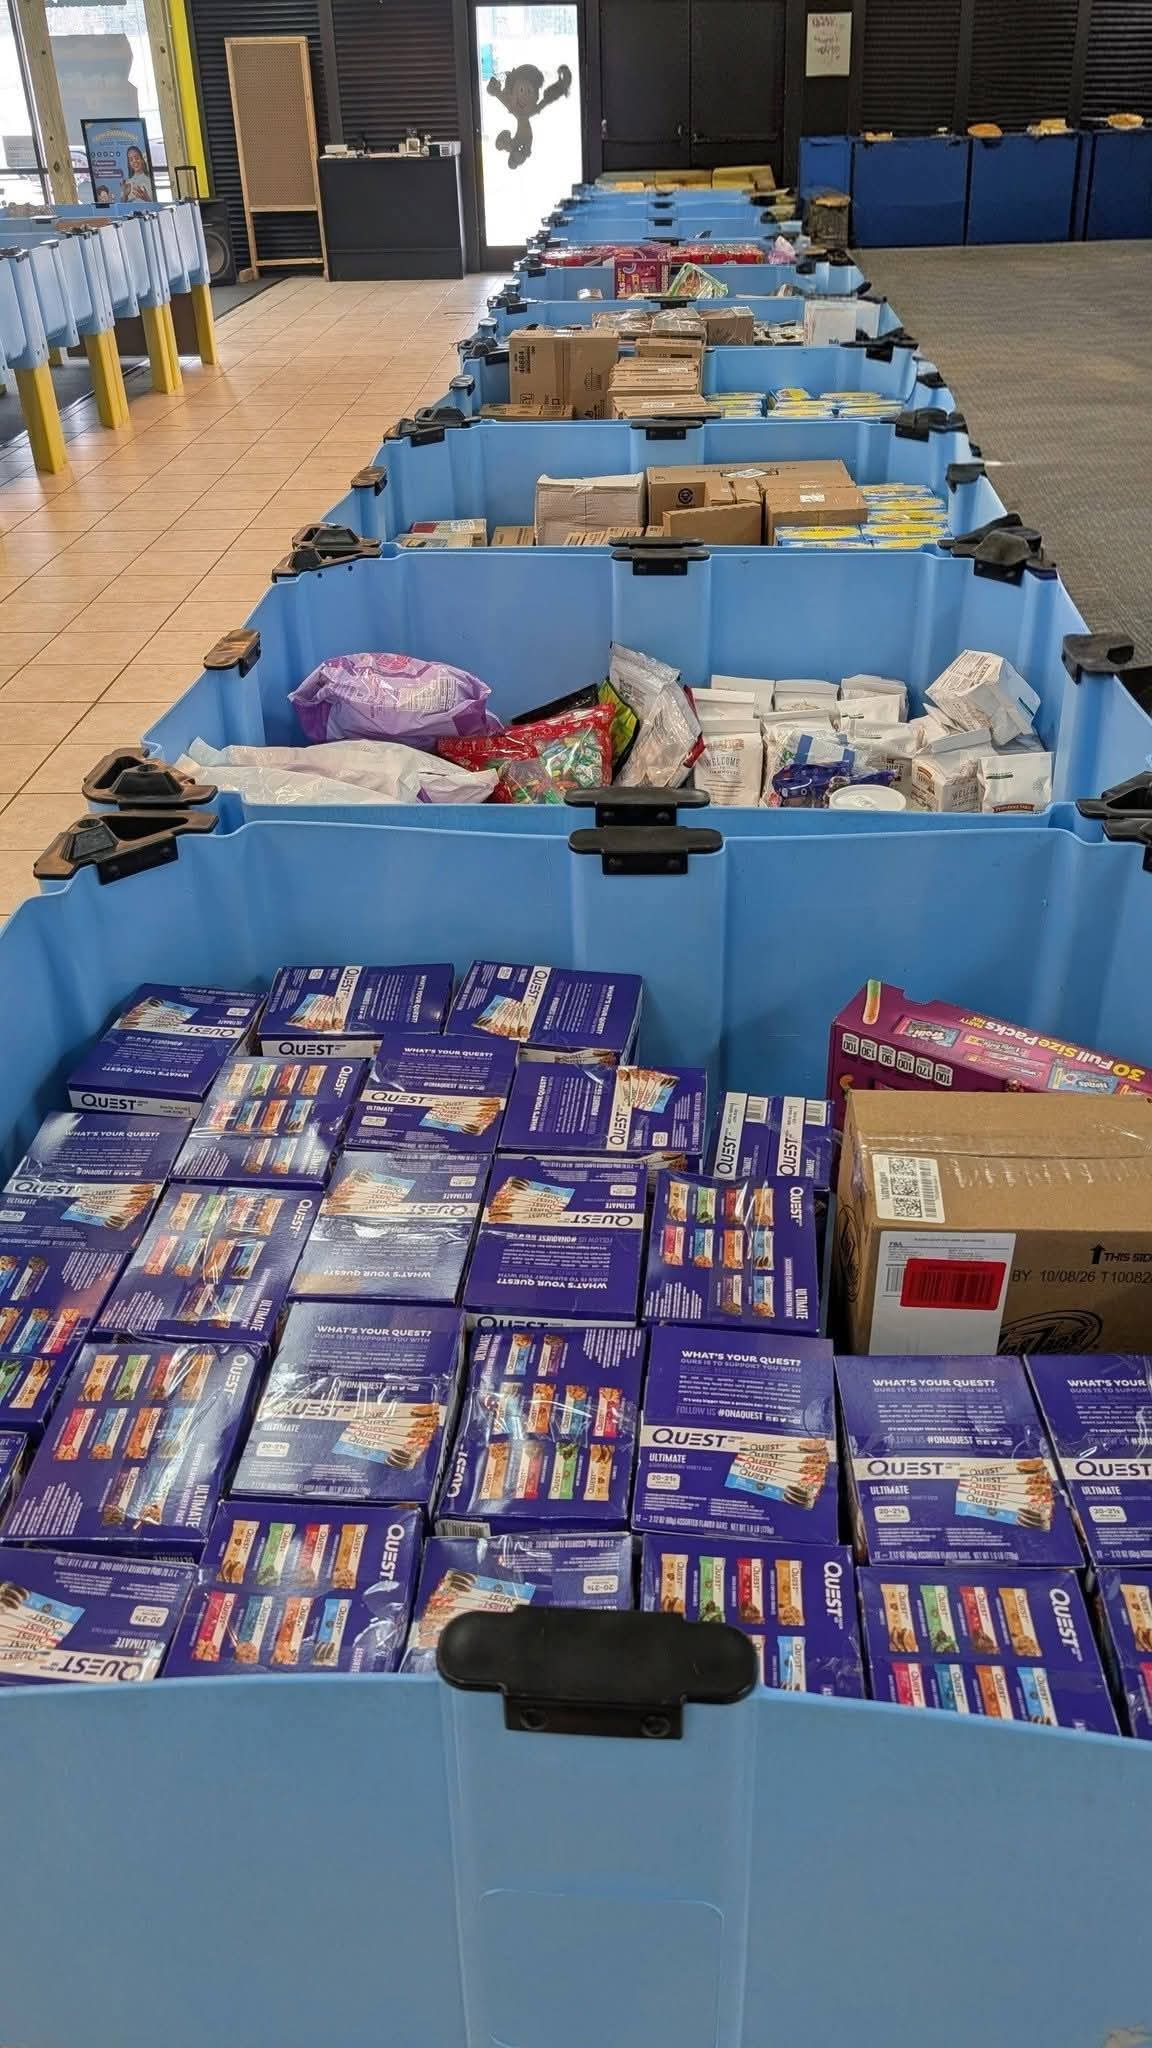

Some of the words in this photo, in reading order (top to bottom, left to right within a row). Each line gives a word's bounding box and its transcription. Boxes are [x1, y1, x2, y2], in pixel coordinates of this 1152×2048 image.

[340, 968, 360, 993] QUEST
[528, 970, 548, 1000] QUEST
[185, 1025, 235, 1038] QUEST
[984, 1020, 1040, 1046] Packs
[278, 1042, 334, 1056] QUEST
[462, 1050, 494, 1058] QUEST?
[1037, 1037, 1079, 1059] Size
[1077, 1049, 1113, 1072] Full
[101, 1066, 132, 1074] QUEST?
[133, 1068, 156, 1076] YOUR
[158, 1070, 189, 1079] WHAT'S
[1112, 1061, 1146, 1082] 30
[334, 1066, 353, 1095] QUEST
[81, 1094, 137, 1111] QUEST
[371, 1092, 428, 1105] QUEST
[366, 1105, 394, 1113] ULTIMATE
[609, 1112, 629, 1146] QUEST
[716, 1136, 737, 1175] QUEST
[780, 1138, 798, 1177] QUEST
[14, 1182, 76, 1196] QUEST
[412, 1204, 468, 1217] QUEST
[605, 1202, 636, 1210] ULTIMATE
[790, 1186, 804, 1223] QUEST
[291, 1199, 313, 1233] QUEST
[570, 1214, 633, 1227] QUEST
[1104, 1252, 1131, 1262] THIS
[324, 1270, 362, 1278] QUEST?
[363, 1270, 390, 1278] YOUR
[392, 1270, 431, 1278] WHAT'S
[1012, 1270, 1032, 1282] BY
[1040, 1270, 1097, 1283] 10/08/26
[497, 1278, 536, 1287] QUEST?
[537, 1280, 566, 1288] YOUR
[568, 1281, 608, 1290] WHAT'S
[795, 1288, 809, 1320] ULTIMATE
[250, 1300, 273, 1332] ULTIMATE
[316, 1326, 358, 1334] WHAT'S
[360, 1328, 391, 1336] YOUR
[392, 1328, 432, 1338] QUEST?
[682, 1350, 725, 1360] WHAT'S
[727, 1354, 758, 1362] YOUR
[760, 1356, 801, 1367] QUEST?
[224, 1354, 249, 1395] QUEST
[872, 1379, 917, 1387] WHAT'S
[952, 1380, 995, 1388] QUEST?
[1067, 1379, 1112, 1387] WHAT'S
[718, 1408, 764, 1421] #ONAQUEST
[652, 1428, 728, 1448] QUEST
[928, 1436, 973, 1444] #ONAQUEST
[649, 1453, 687, 1464] ULTIMATE
[447, 1451, 468, 1498] QUEST
[738, 1468, 770, 1482] QUEST
[868, 1460, 944, 1477] QUEST
[1076, 1460, 1152, 1477] QUEST
[870, 1485, 910, 1496] ULTIMATE
[1081, 1486, 1122, 1496] ULTIMATE
[186, 1484, 211, 1529] ULTIMATE
[379, 1524, 405, 1580] QUEST
[824, 1562, 843, 1622] QUEST
[938, 1592, 948, 1616] QUEST
[976, 1592, 988, 1618] QUEST
[32, 1614, 63, 1629] QUEST
[1050, 1588, 1075, 1650] QUEST
[115, 1636, 157, 1650] ULTIMATE
[58, 1656, 142, 1681] QUEST
[952, 1671, 964, 1698] QUEST
[1035, 1674, 1049, 1704] QUEST
